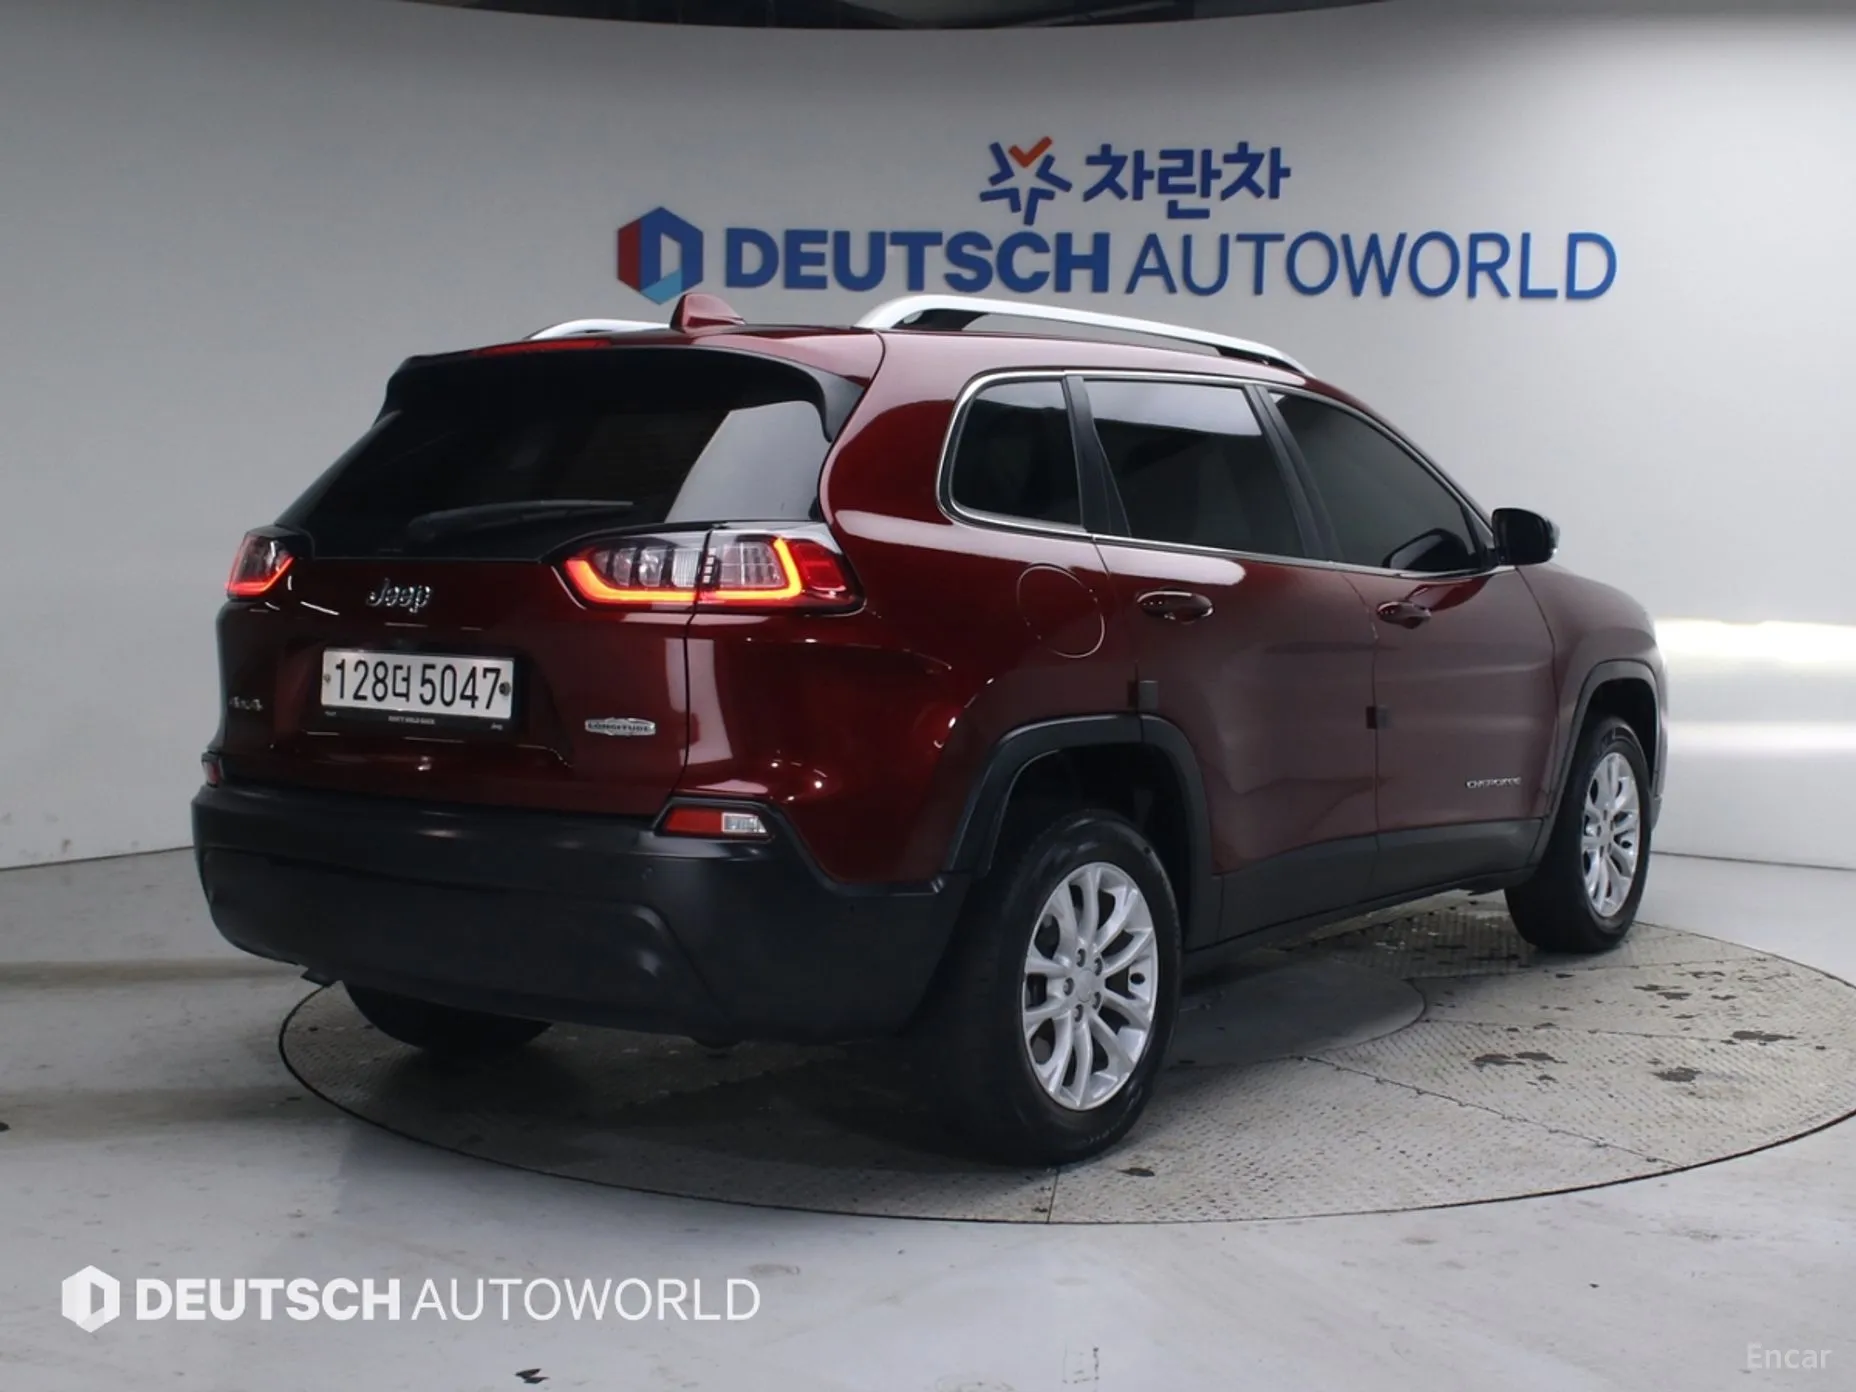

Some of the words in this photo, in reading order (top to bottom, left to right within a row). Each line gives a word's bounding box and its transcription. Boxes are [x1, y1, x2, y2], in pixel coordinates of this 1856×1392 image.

[1083, 141, 1291, 219] 차란차
[725, 228, 1110, 294] DEUTSCH
[1124, 230, 1618, 300] AUTOWORLD
[366, 577, 433, 614] Jeep
